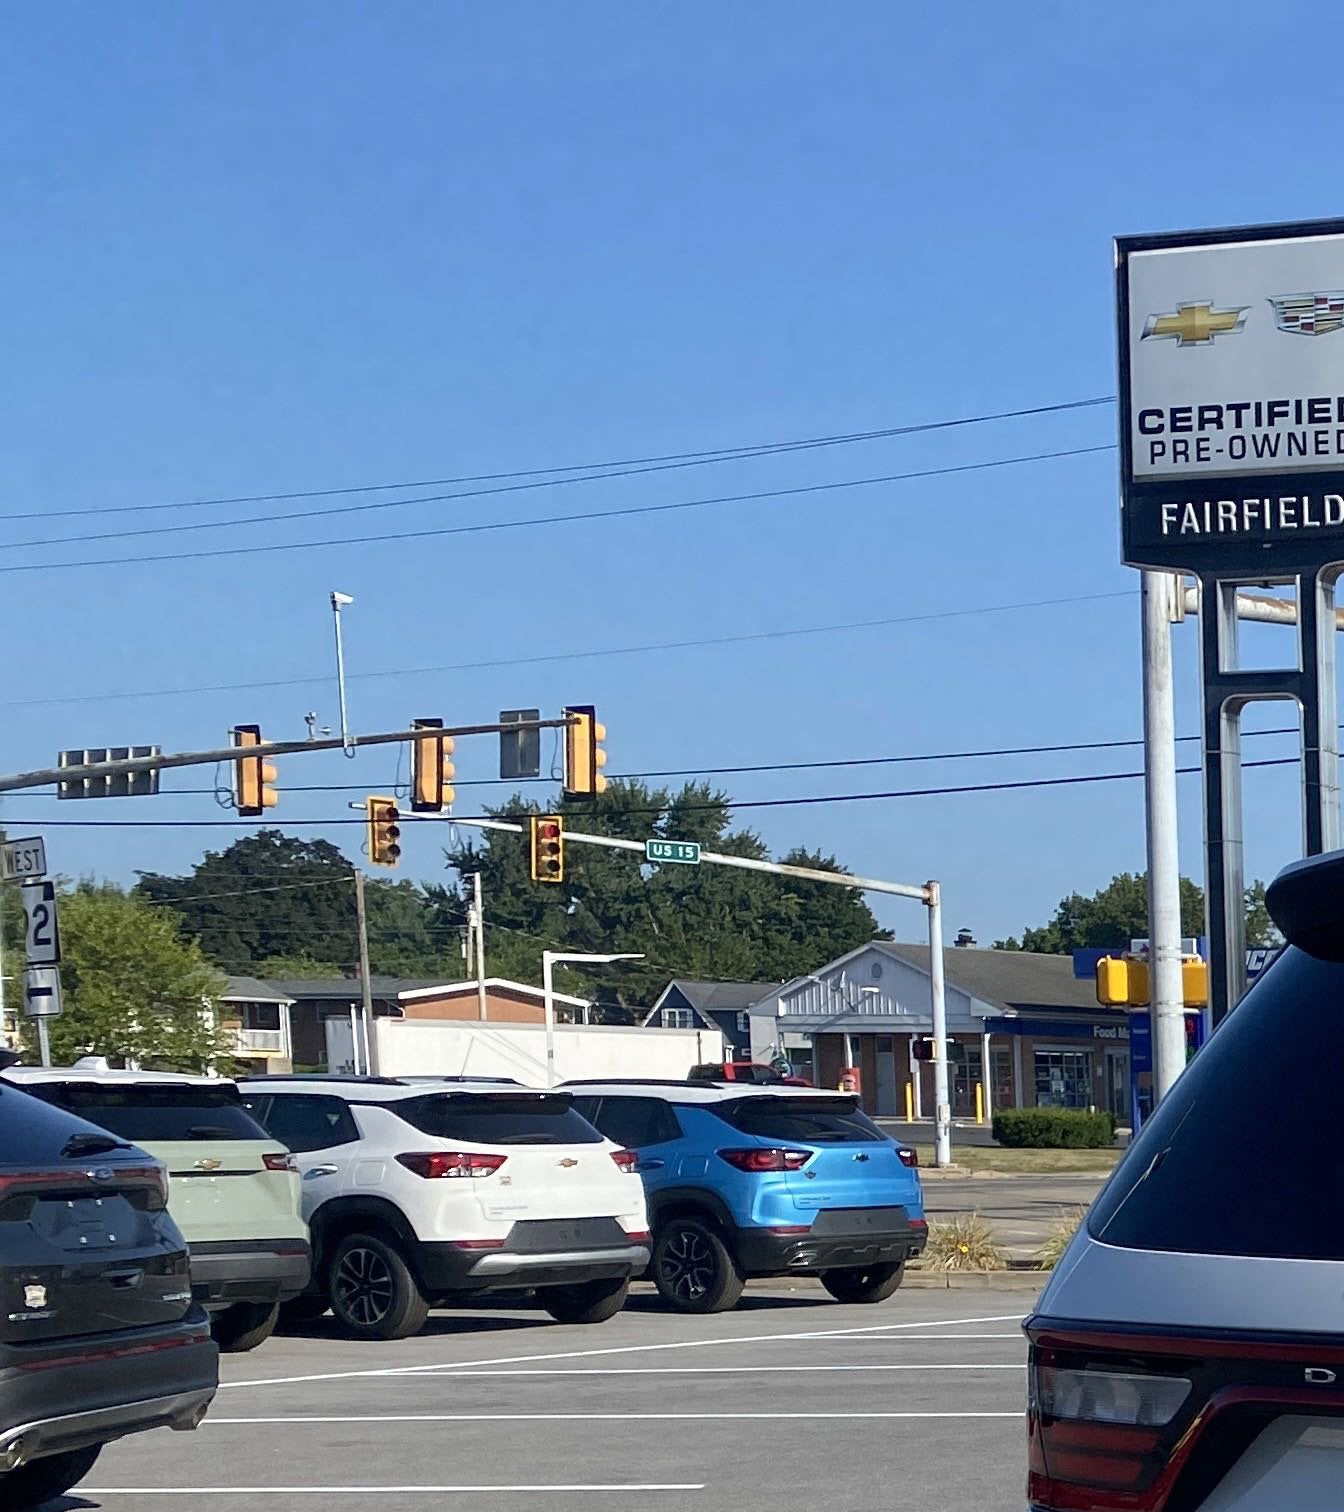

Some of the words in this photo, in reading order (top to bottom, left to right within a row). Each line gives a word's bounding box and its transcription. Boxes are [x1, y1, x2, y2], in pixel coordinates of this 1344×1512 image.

[653, 844, 672, 857] US
[678, 845, 694, 858] 15
[5, 848, 41, 874] WEST
[1093, 1025, 1117, 1039] Food
